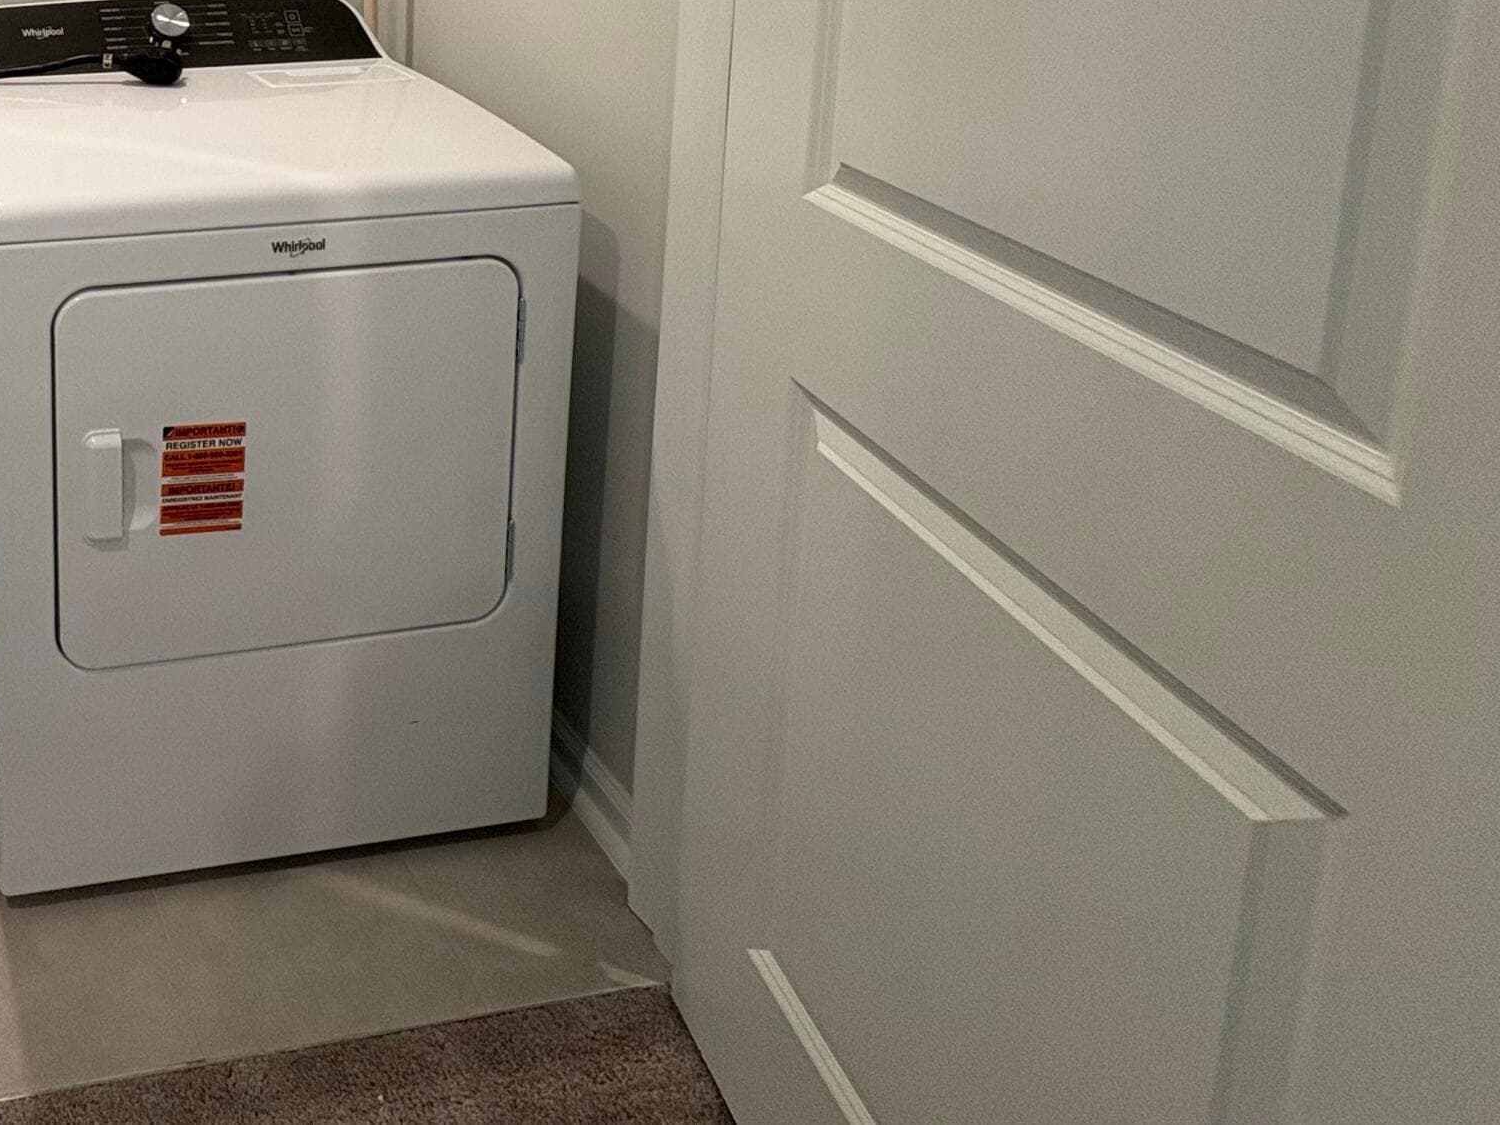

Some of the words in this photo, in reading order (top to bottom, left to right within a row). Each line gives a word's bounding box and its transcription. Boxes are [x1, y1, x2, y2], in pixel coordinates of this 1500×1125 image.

[21, 26, 64, 39] Whirlpool
[271, 237, 326, 256] Whirlpool
[166, 439, 216, 450] REGISTER
[218, 438, 242, 447] NOW
